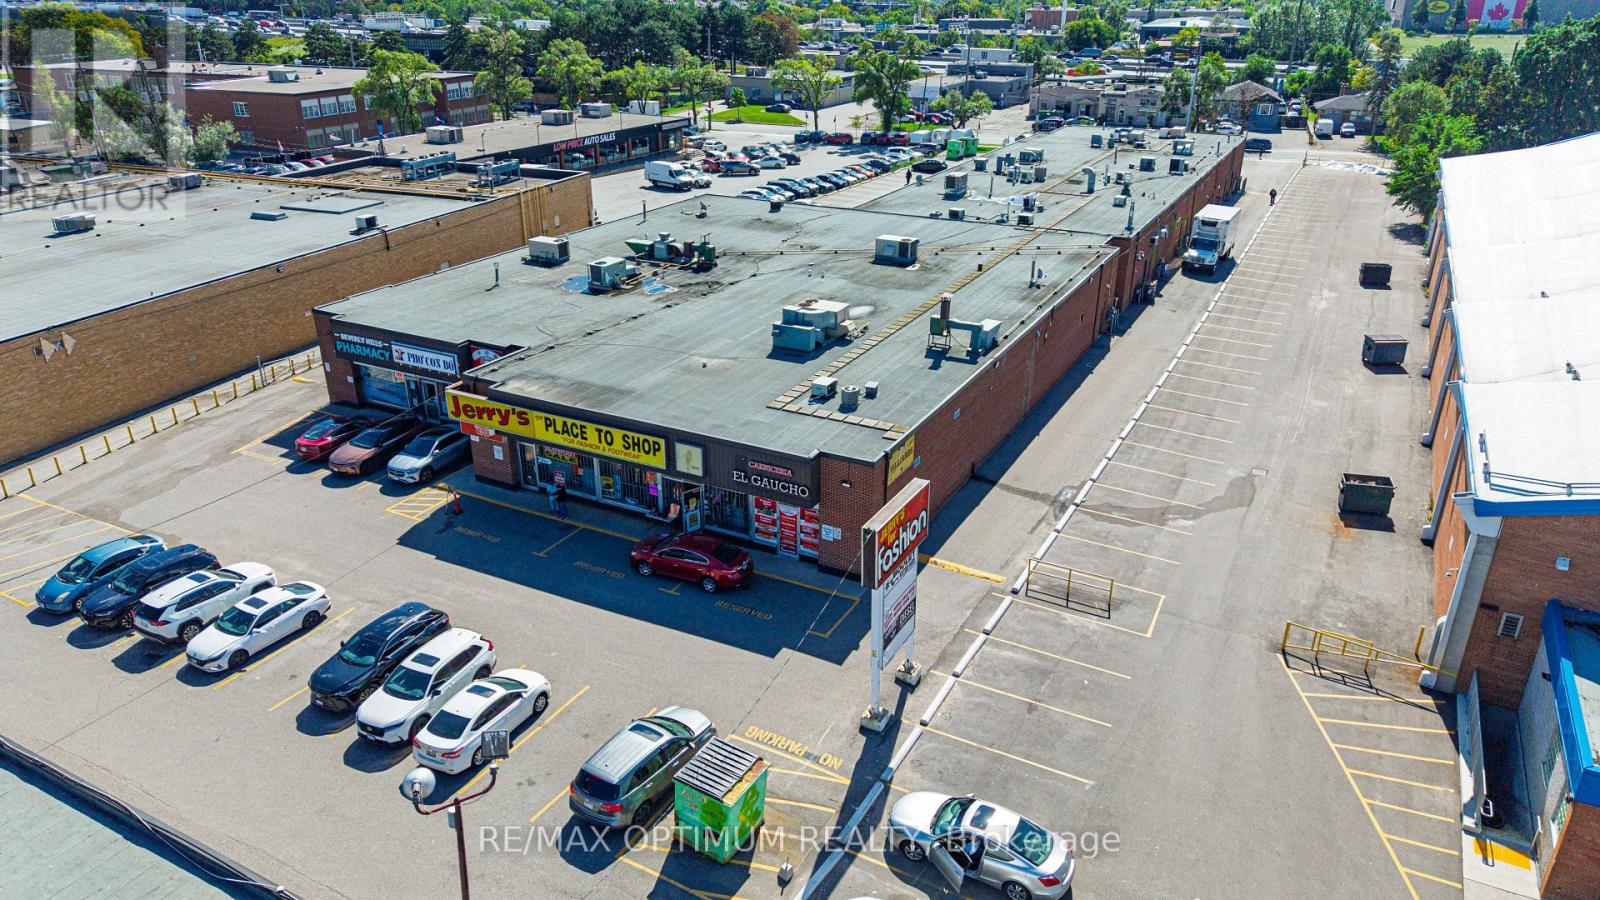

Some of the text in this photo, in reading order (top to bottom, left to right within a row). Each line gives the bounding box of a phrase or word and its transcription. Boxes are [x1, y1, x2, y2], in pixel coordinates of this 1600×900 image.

[567, 138, 584, 149] PRICE
[584, 135, 600, 146] AUTO
[600, 132, 616, 143] SALES
[335, 340, 391, 362] PHARMACY
[450, 395, 531, 427] Jerry's
[544, 416, 588, 441] PLACE
[595, 427, 614, 446] TO
[622, 433, 661, 457] SHOP
[732, 470, 809, 498] EL GAUCHO
[714, 600, 774, 621] RESERVED
[744, 725, 845, 770] NO PARKING
